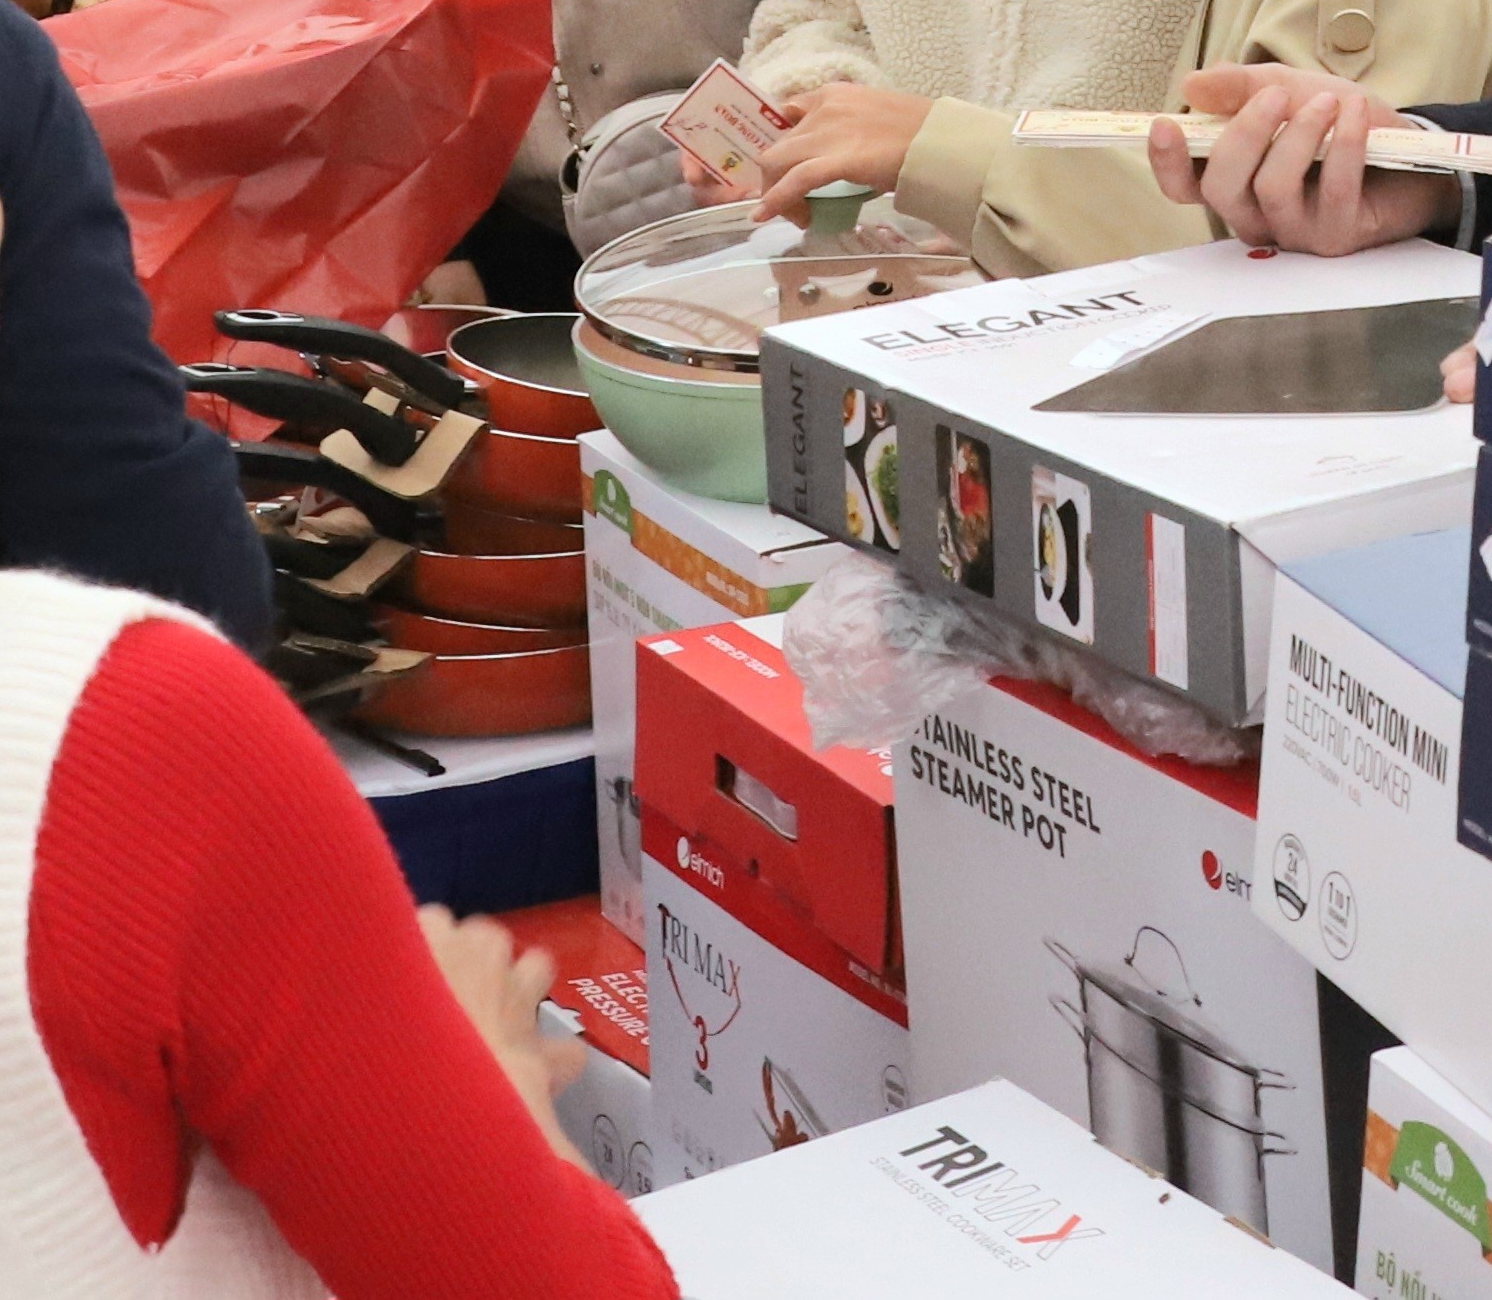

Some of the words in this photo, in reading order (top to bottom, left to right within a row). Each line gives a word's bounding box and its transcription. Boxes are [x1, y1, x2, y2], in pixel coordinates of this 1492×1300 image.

[861, 290, 1146, 351] ELEGANT
[789, 362, 808, 515] ELEGANT
[1285, 682, 1352, 767] ELECTRIC
[1353, 735, 1412, 815] COOKER
[1289, 633, 1410, 758] MULTI-FUNCTION
[1412, 724, 1449, 786] MINI
[910, 744, 1016, 832] STEAMER
[1022, 804, 1067, 859] POT
[1031, 766, 1101, 834] STEEL
[689, 852, 725, 890] elmich
[657, 902, 689, 966] TRI
[693, 933, 741, 998] MAX
[567, 977, 646, 1038] PRESSURE
[695, 1015, 709, 1071] 3
[898, 1125, 1107, 1262] TRIMAX
[1404, 1159, 1447, 1202] Smart
[1447, 1197, 1478, 1227] cook
